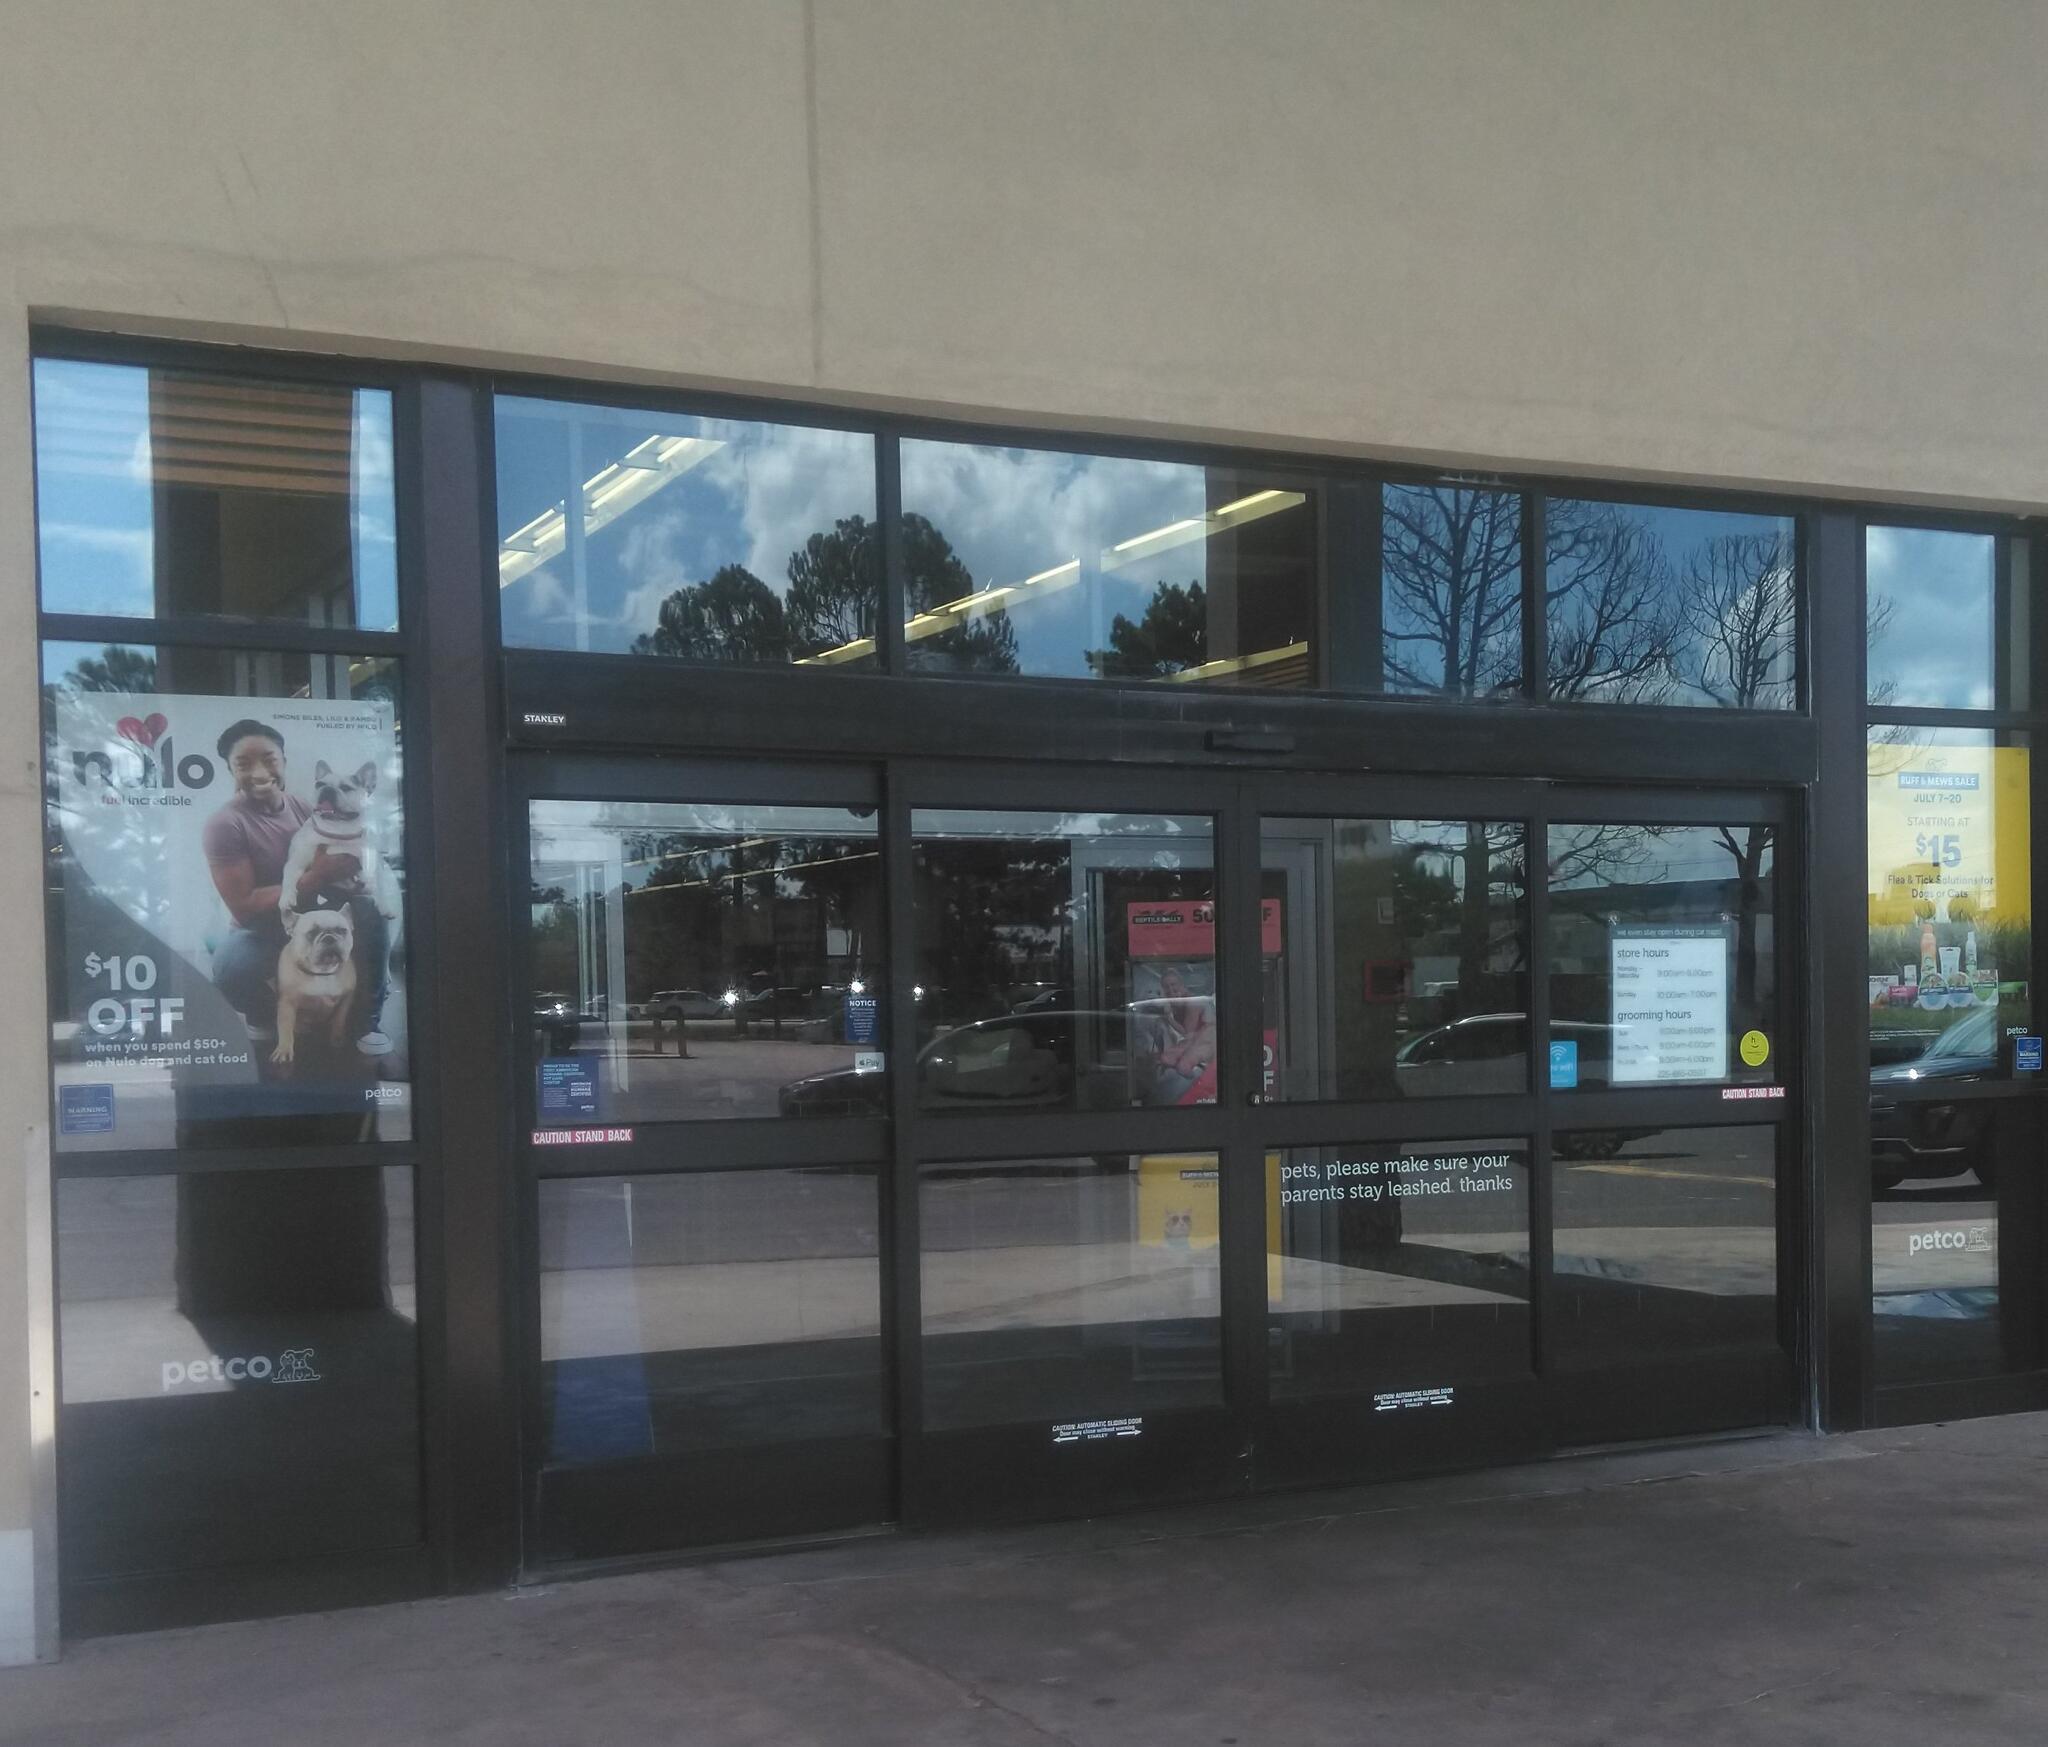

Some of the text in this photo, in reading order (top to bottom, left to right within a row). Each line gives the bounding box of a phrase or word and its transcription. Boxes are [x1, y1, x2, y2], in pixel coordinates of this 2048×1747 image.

[524, 714, 565, 723] STANLEY
[1900, 775, 1920, 785] RUFF
[1927, 776, 1954, 785] MEWS
[1955, 777, 1976, 786] SALE
[127, 795, 192, 807] incredible
[1913, 793, 1937, 804] JULY
[1907, 816, 1971, 827] STARTING AT
[1916, 832, 1962, 868] $15
[1888, 874, 1905, 885] Flea
[1915, 874, 1933, 885] Tick
[1617, 948, 1670, 958] store hours
[84, 952, 157, 991] $10
[87, 997, 185, 1035] OFF
[1617, 1010, 1692, 1022] grooming hours
[2006, 1025, 2028, 1036] petco
[85, 1037, 227, 1055] when you spend $50+
[139, 1055, 165, 1068] dog
[167, 1055, 191, 1065] and
[195, 1054, 215, 1064] cat
[218, 1052, 248, 1064] food
[365, 1087, 402, 1101] petco
[1722, 1087, 1785, 1099] CAUTION STAND BACK
[533, 1129, 632, 1145] CAUTION STAND BACK
[1281, 1155, 1510, 1182] pets, please make sure your
[1281, 1183, 1345, 1207] parents
[1349, 1183, 1383, 1202] stay
[1459, 1175, 1513, 1193] thanks
[1909, 1229, 1966, 1256] petco
[162, 1354, 272, 1392] petco
[1396, 1390, 1422, 1399] AUTOMATIC
[1077, 1420, 1106, 1430] AUTOMATIC
[1128, 1417, 1142, 1425] DOOR
